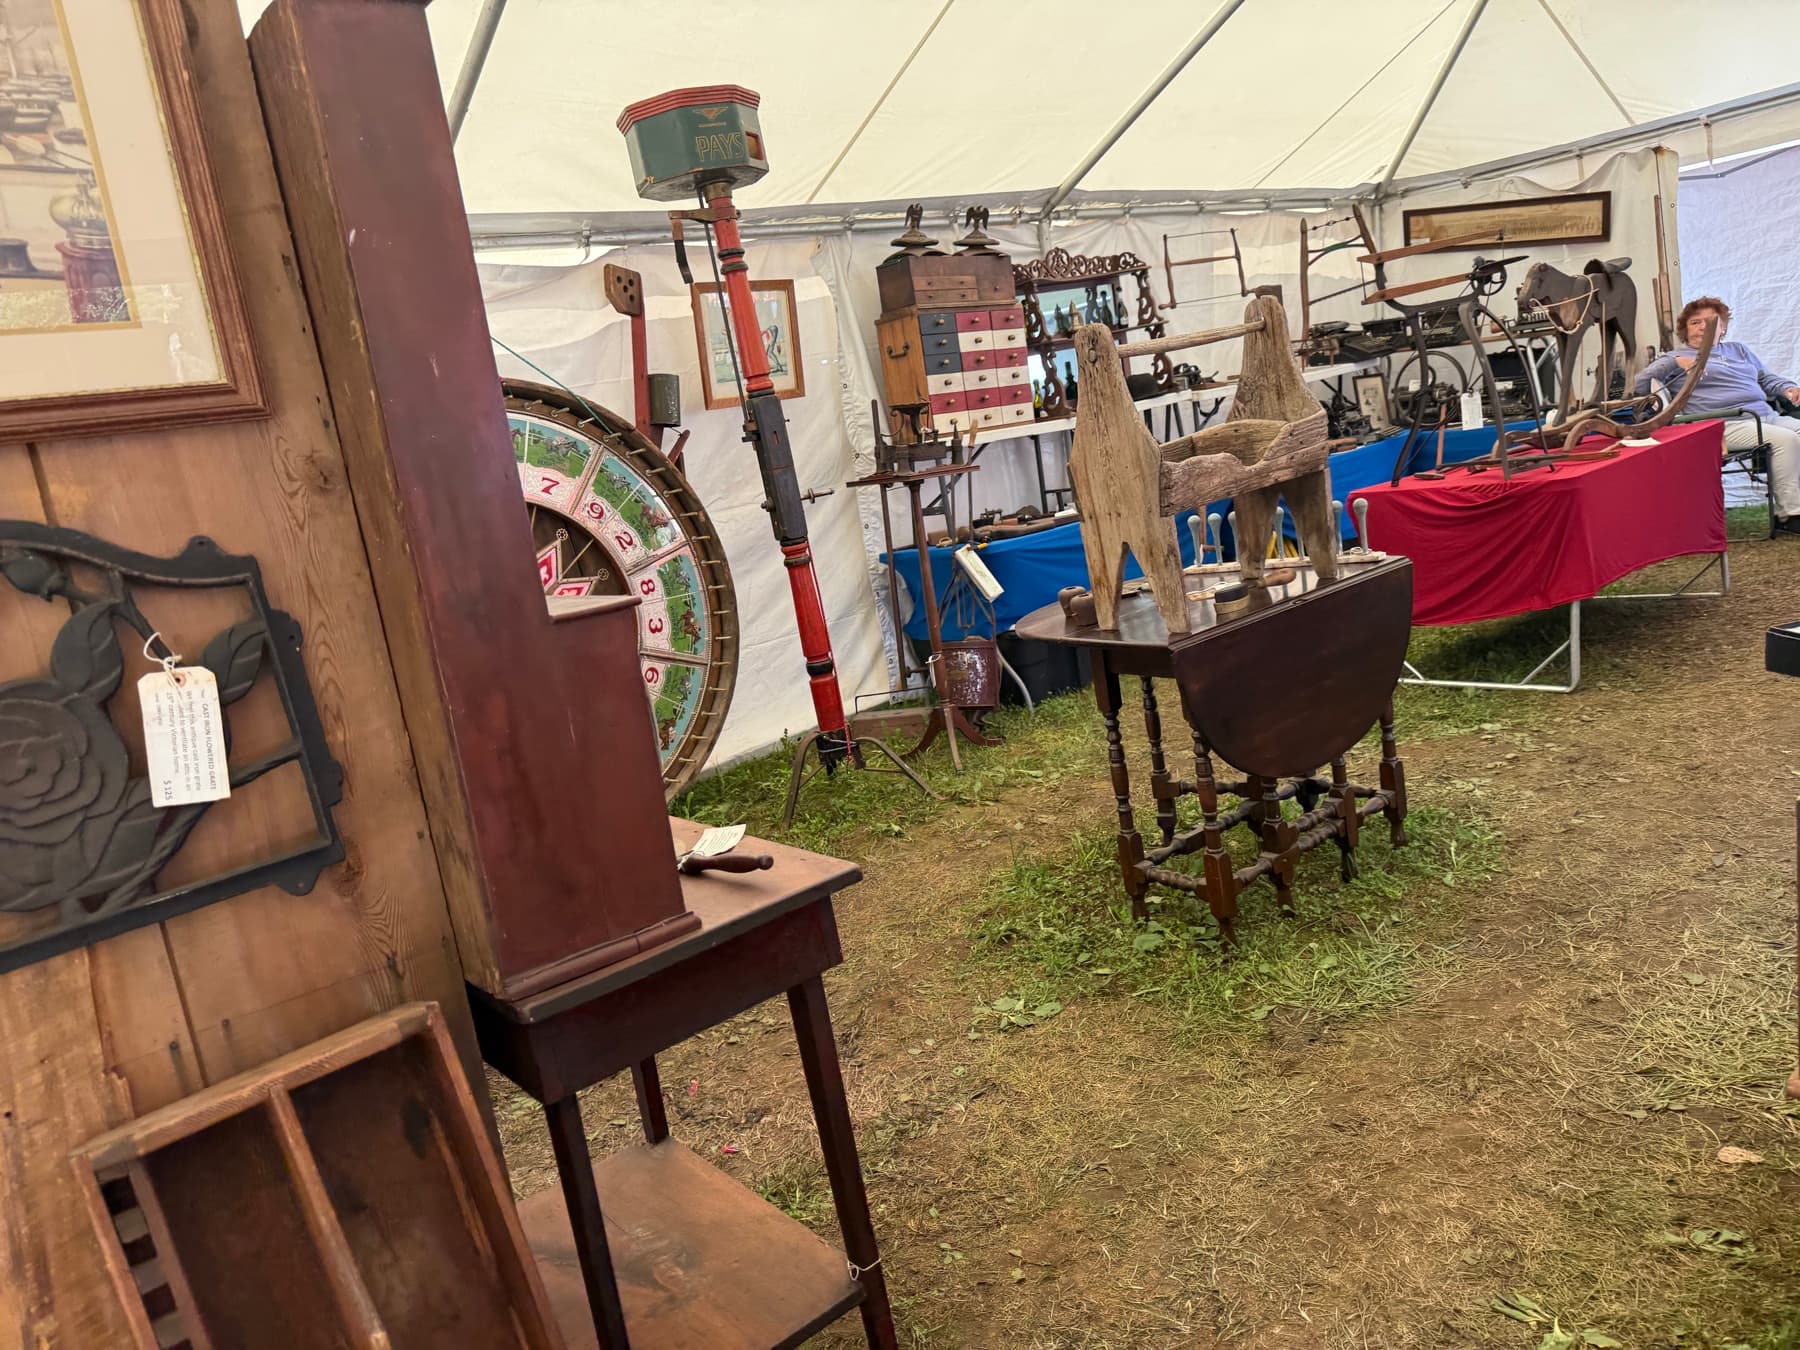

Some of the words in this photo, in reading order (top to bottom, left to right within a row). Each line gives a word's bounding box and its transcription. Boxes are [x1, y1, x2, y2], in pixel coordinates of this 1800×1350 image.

[696, 132, 744, 162] PAYS
[541, 477, 560, 496] 7
[587, 502, 604, 520] 9
[615, 531, 634, 550] 2
[640, 579, 655, 595] 8
[648, 618, 663, 634] 3
[644, 667, 659, 684] 6
[206, 737, 214, 769] FLOWERED
[164, 787, 173, 800] 125
